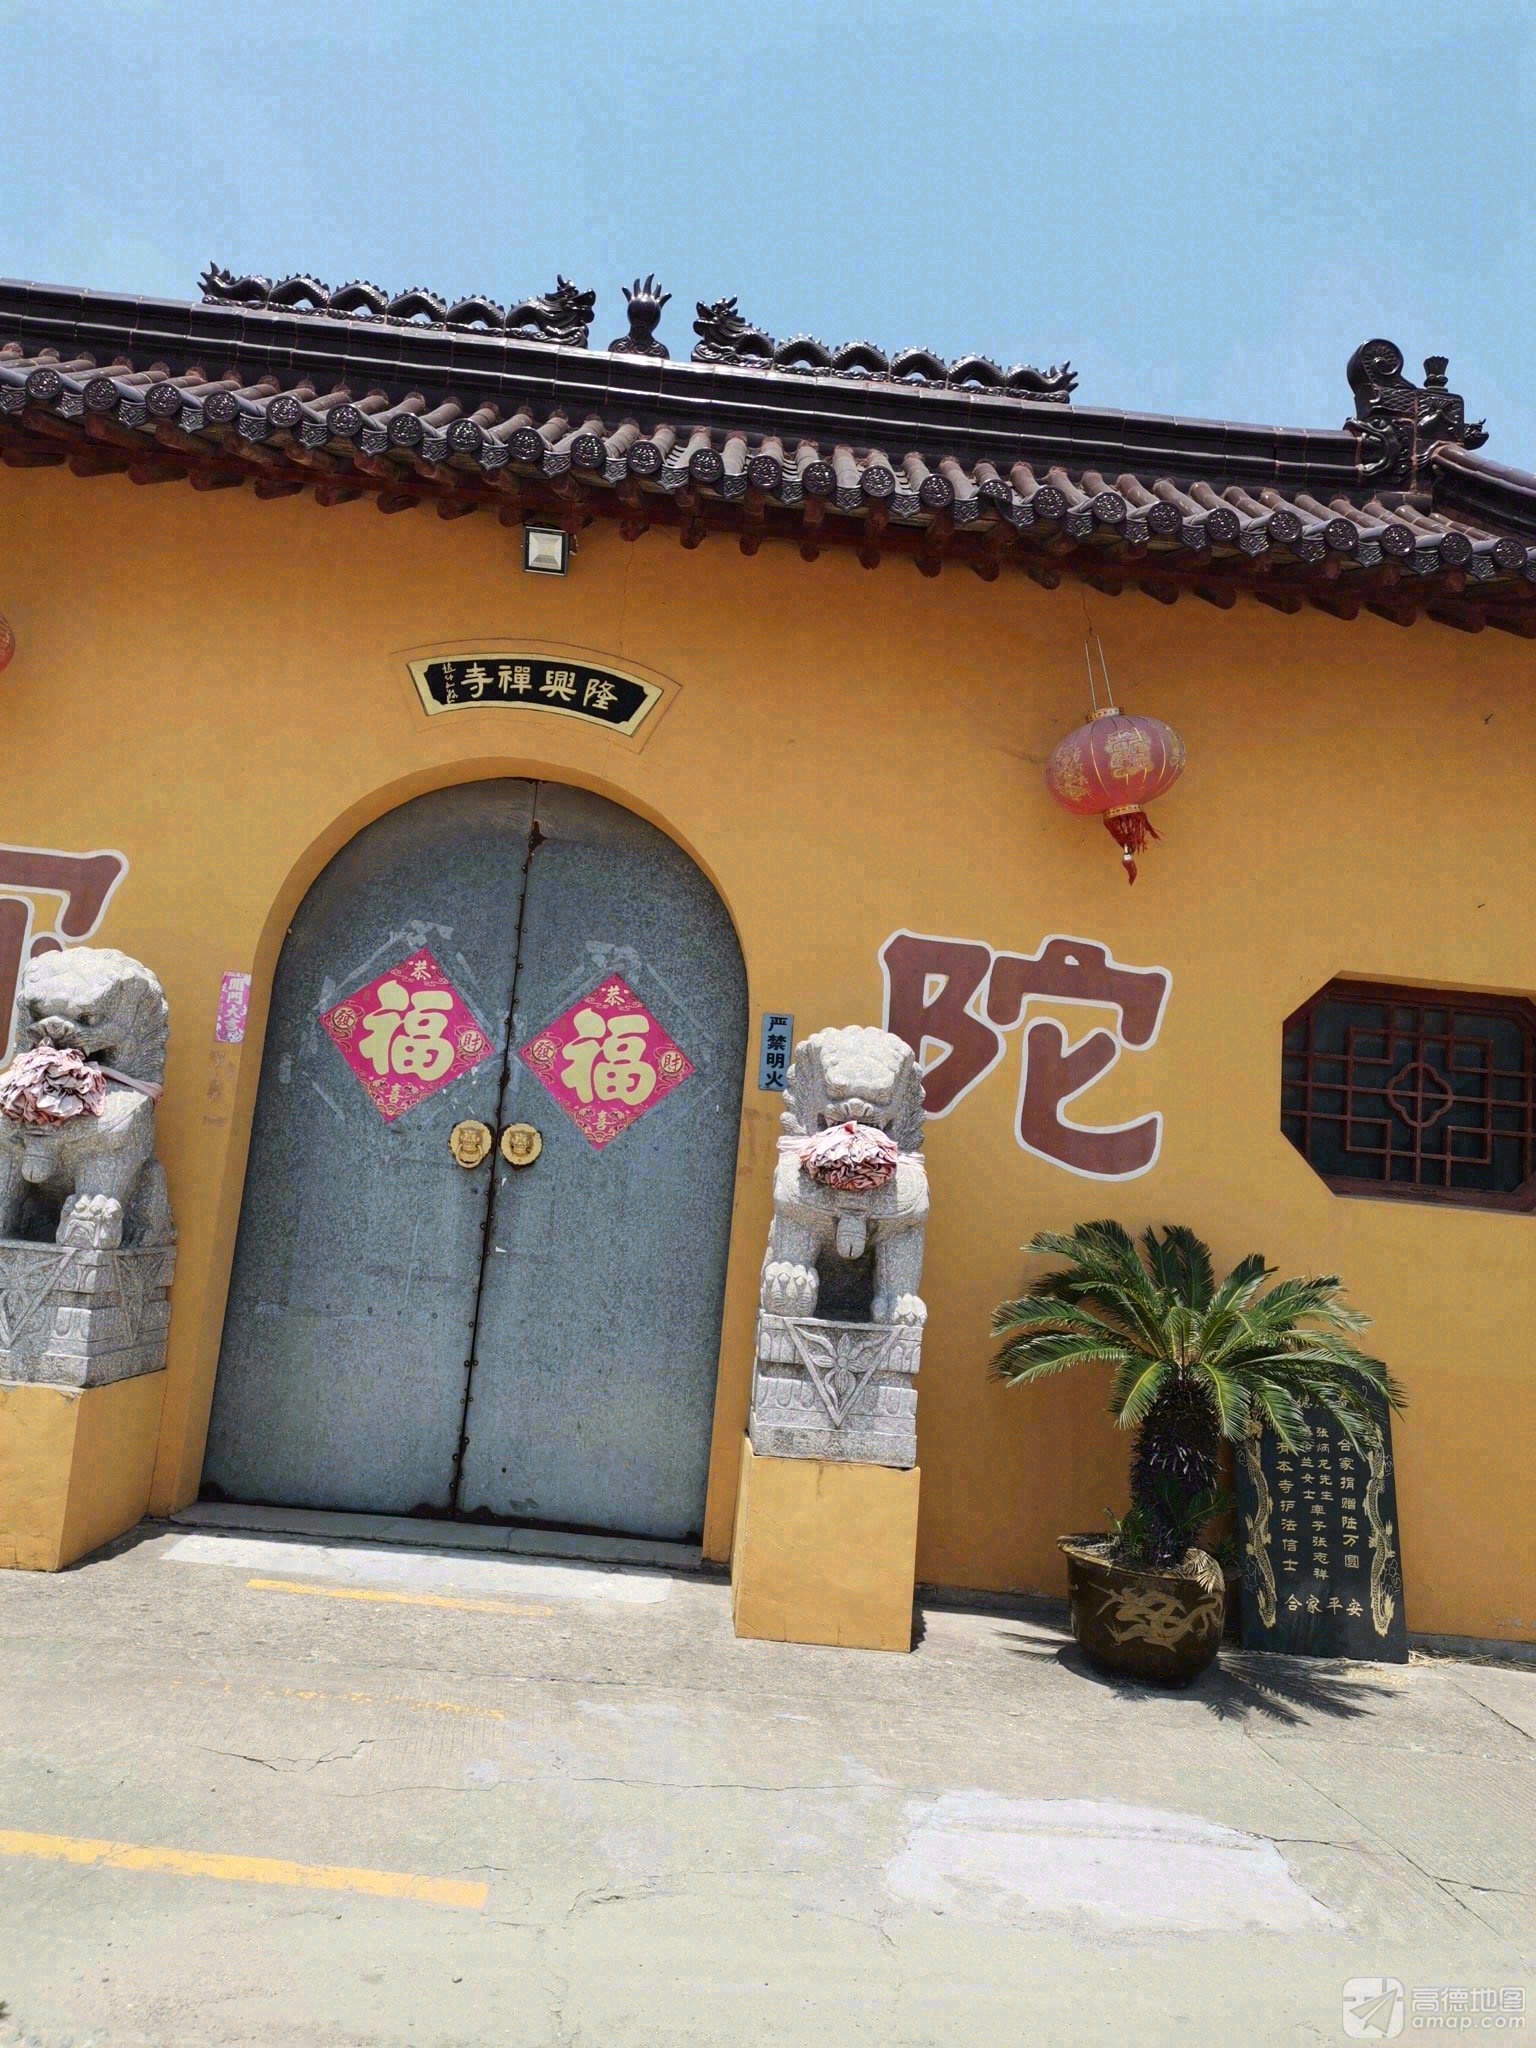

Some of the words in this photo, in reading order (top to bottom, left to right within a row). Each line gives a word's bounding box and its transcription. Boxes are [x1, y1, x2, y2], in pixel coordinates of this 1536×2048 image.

[460, 662, 619, 710] 隆興禪寺
[410, 960, 431, 980] 恭
[604, 985, 625, 1006] 恭
[358, 980, 455, 1081] 福
[463, 1033, 481, 1050] 財
[561, 1008, 656, 1105] 福
[663, 1053, 682, 1071] 財
[765, 1016, 788, 1088] 严禁明火
[878, 928, 1172, 1182] 陀
[1284, 1593, 1364, 1617] 合家平安
